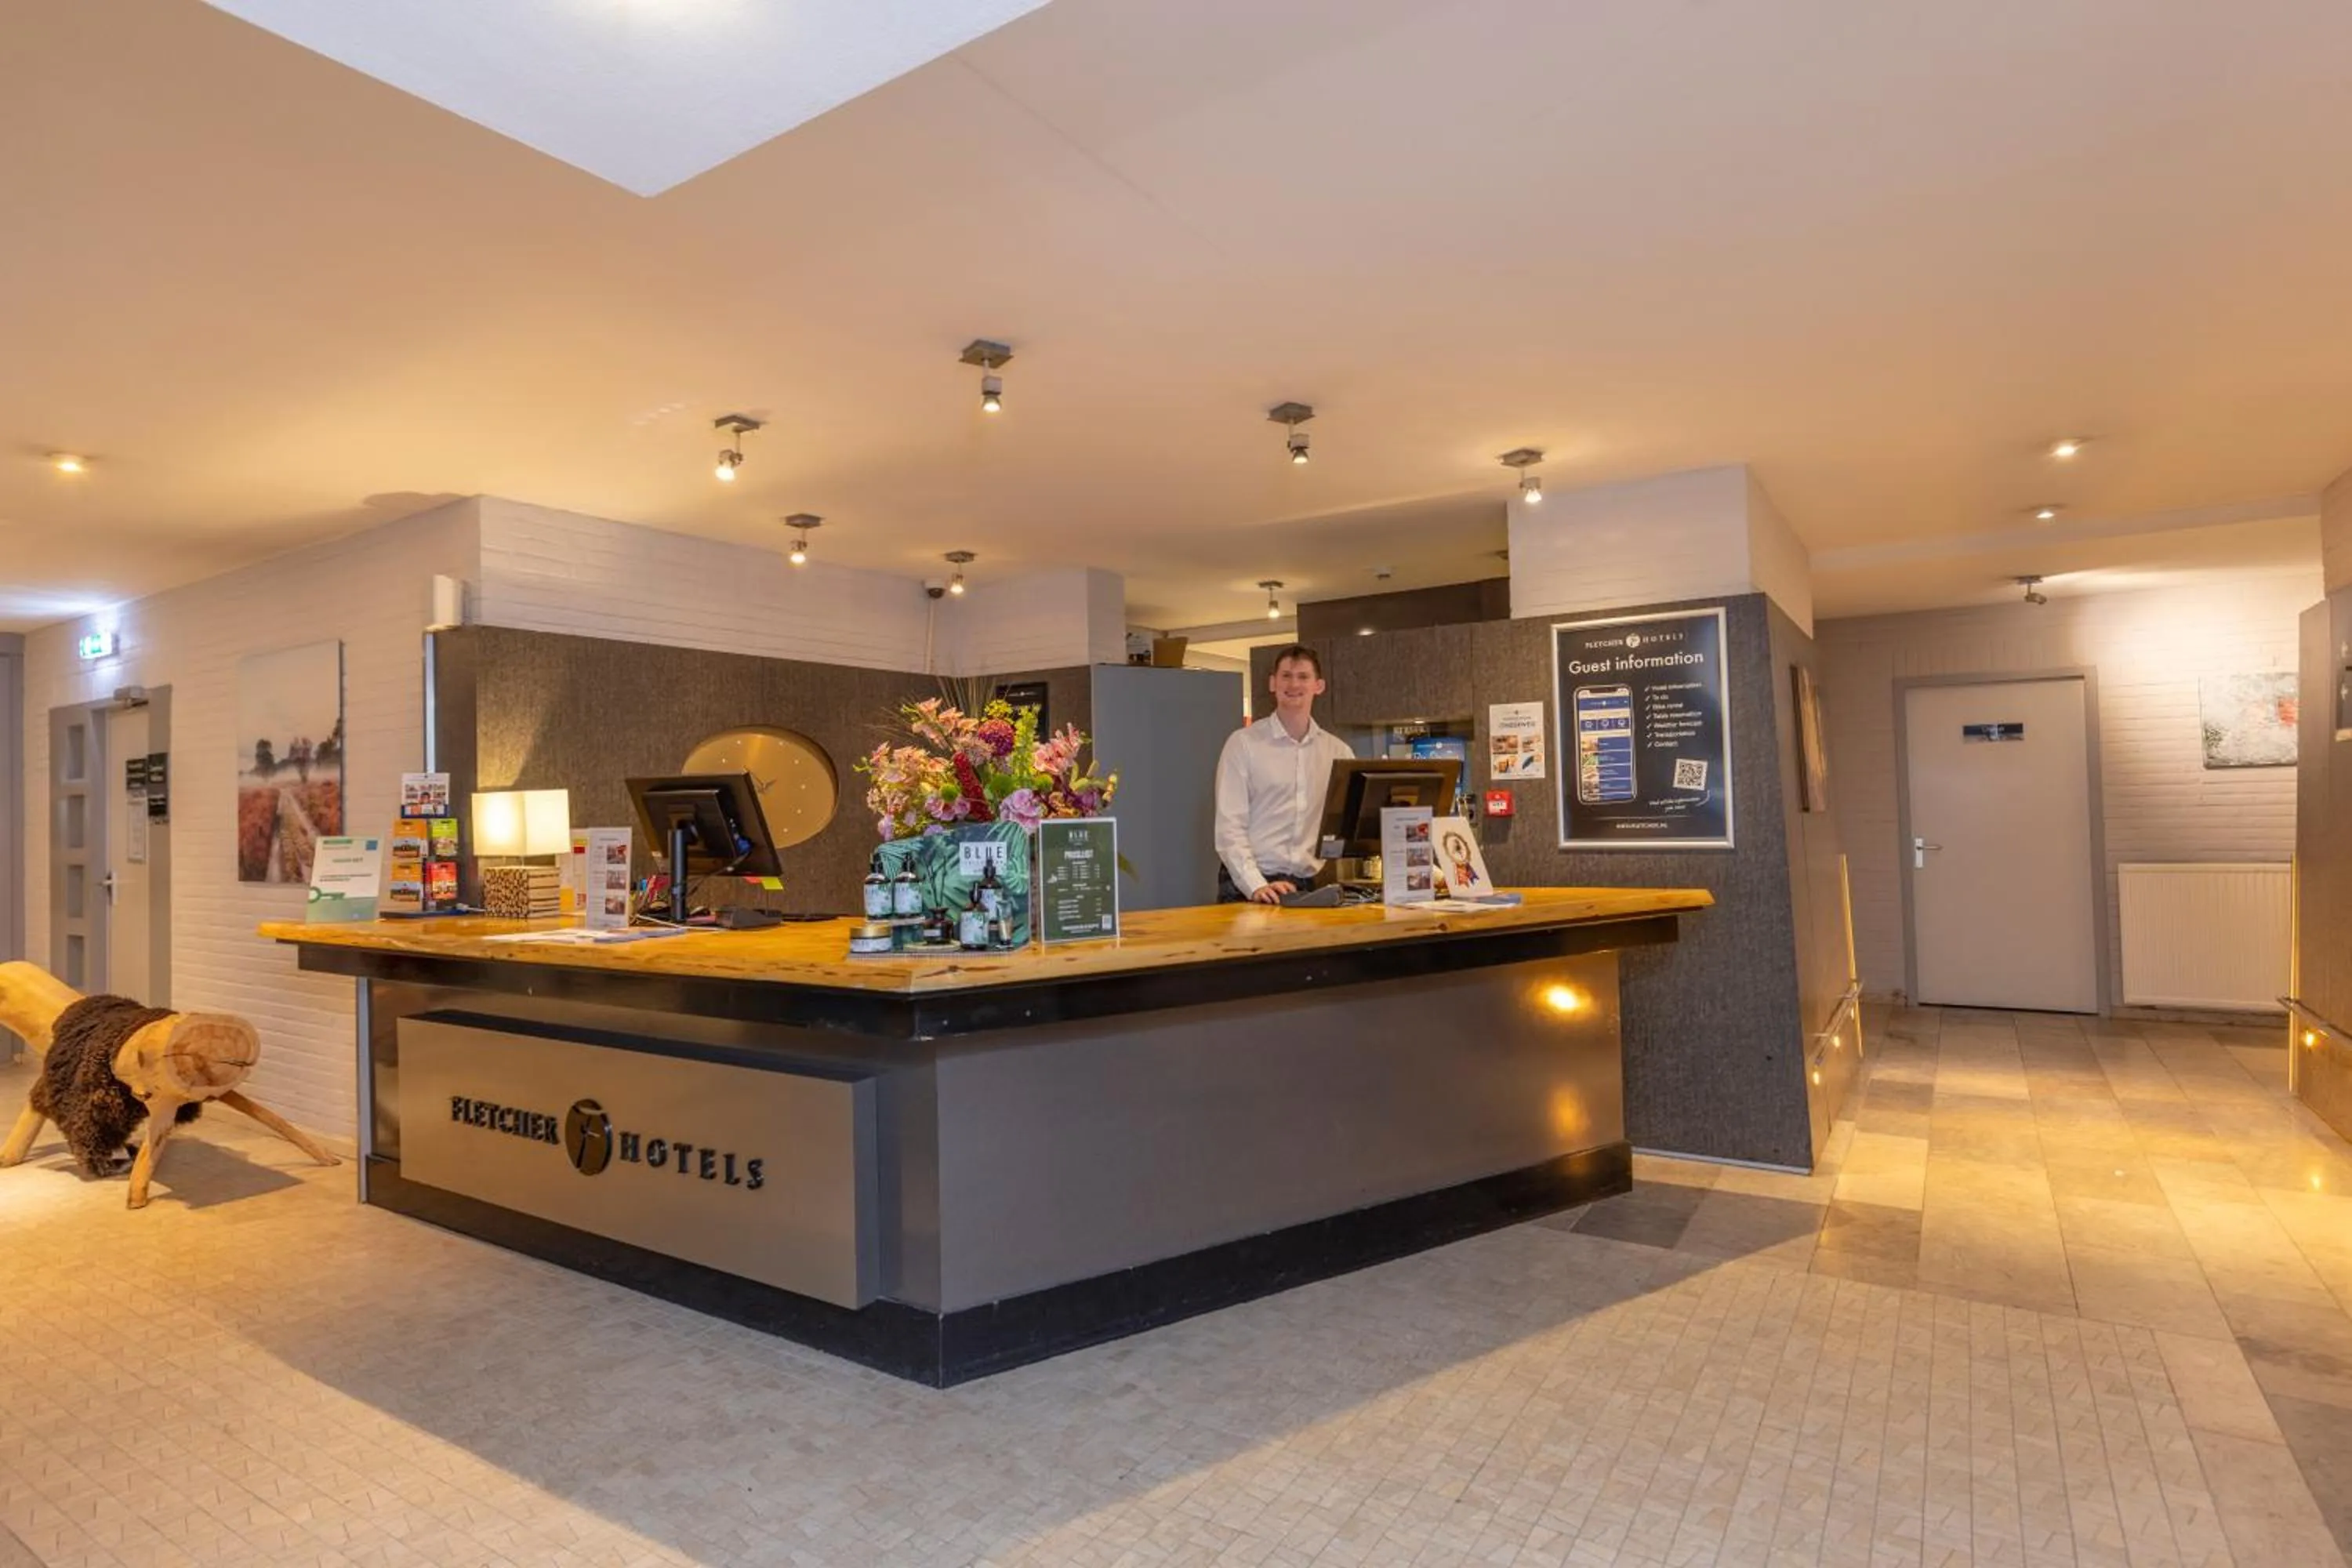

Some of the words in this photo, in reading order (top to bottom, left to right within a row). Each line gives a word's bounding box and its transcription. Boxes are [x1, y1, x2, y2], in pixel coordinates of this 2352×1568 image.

[1569, 659, 1611, 675] Guest
[1615, 652, 1704, 670] information
[964, 846, 1004, 859] BLUE
[450, 1095, 561, 1145] FLETCHER
[619, 1131, 766, 1191] HOTELS
